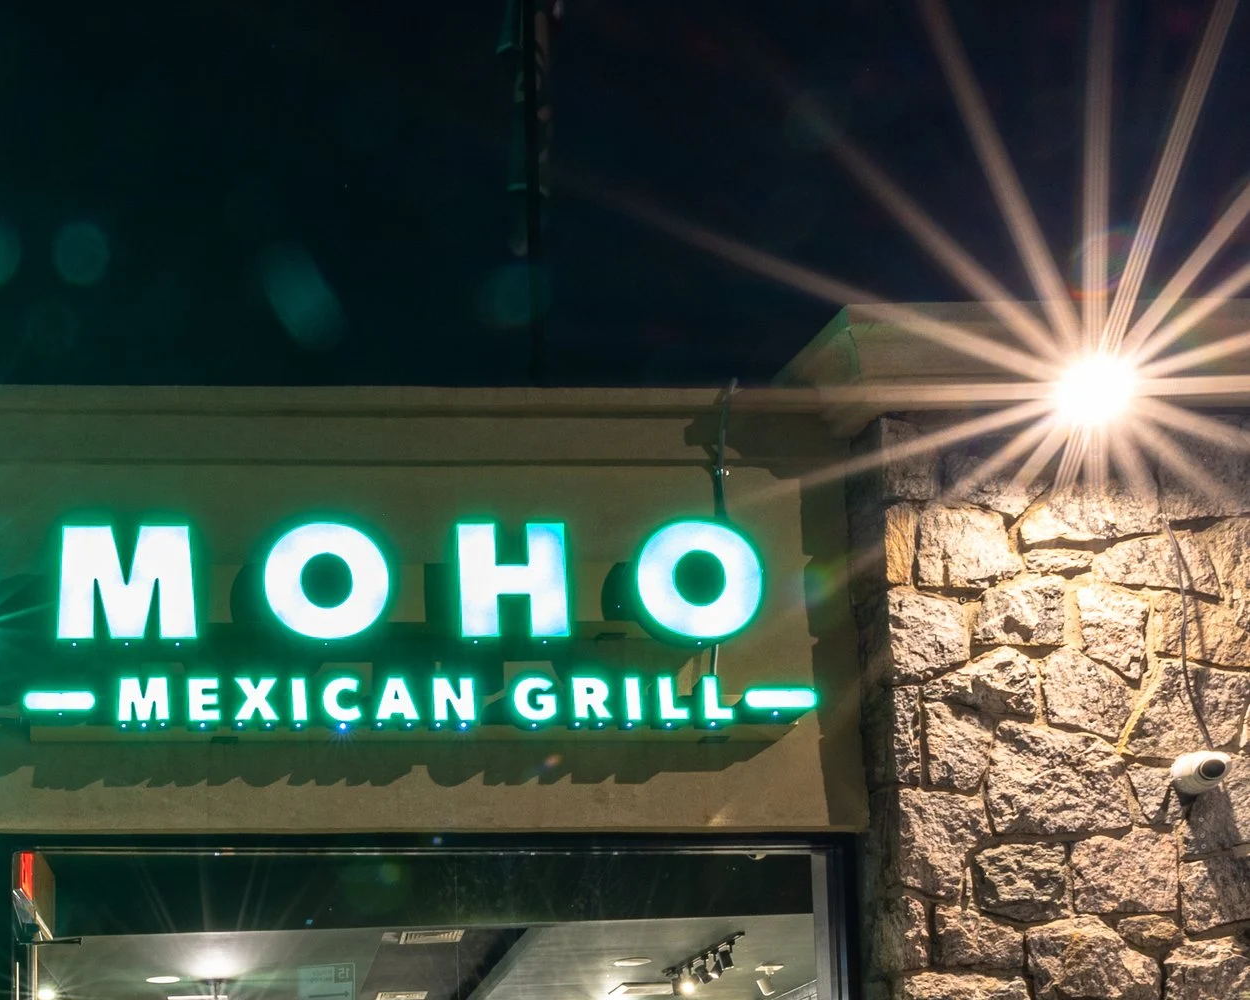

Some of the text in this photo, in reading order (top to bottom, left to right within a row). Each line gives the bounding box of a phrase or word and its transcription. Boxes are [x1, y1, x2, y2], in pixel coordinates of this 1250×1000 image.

[57, 521, 762, 639] MOHO
[117, 673, 734, 723] MEXICAN GRILL
